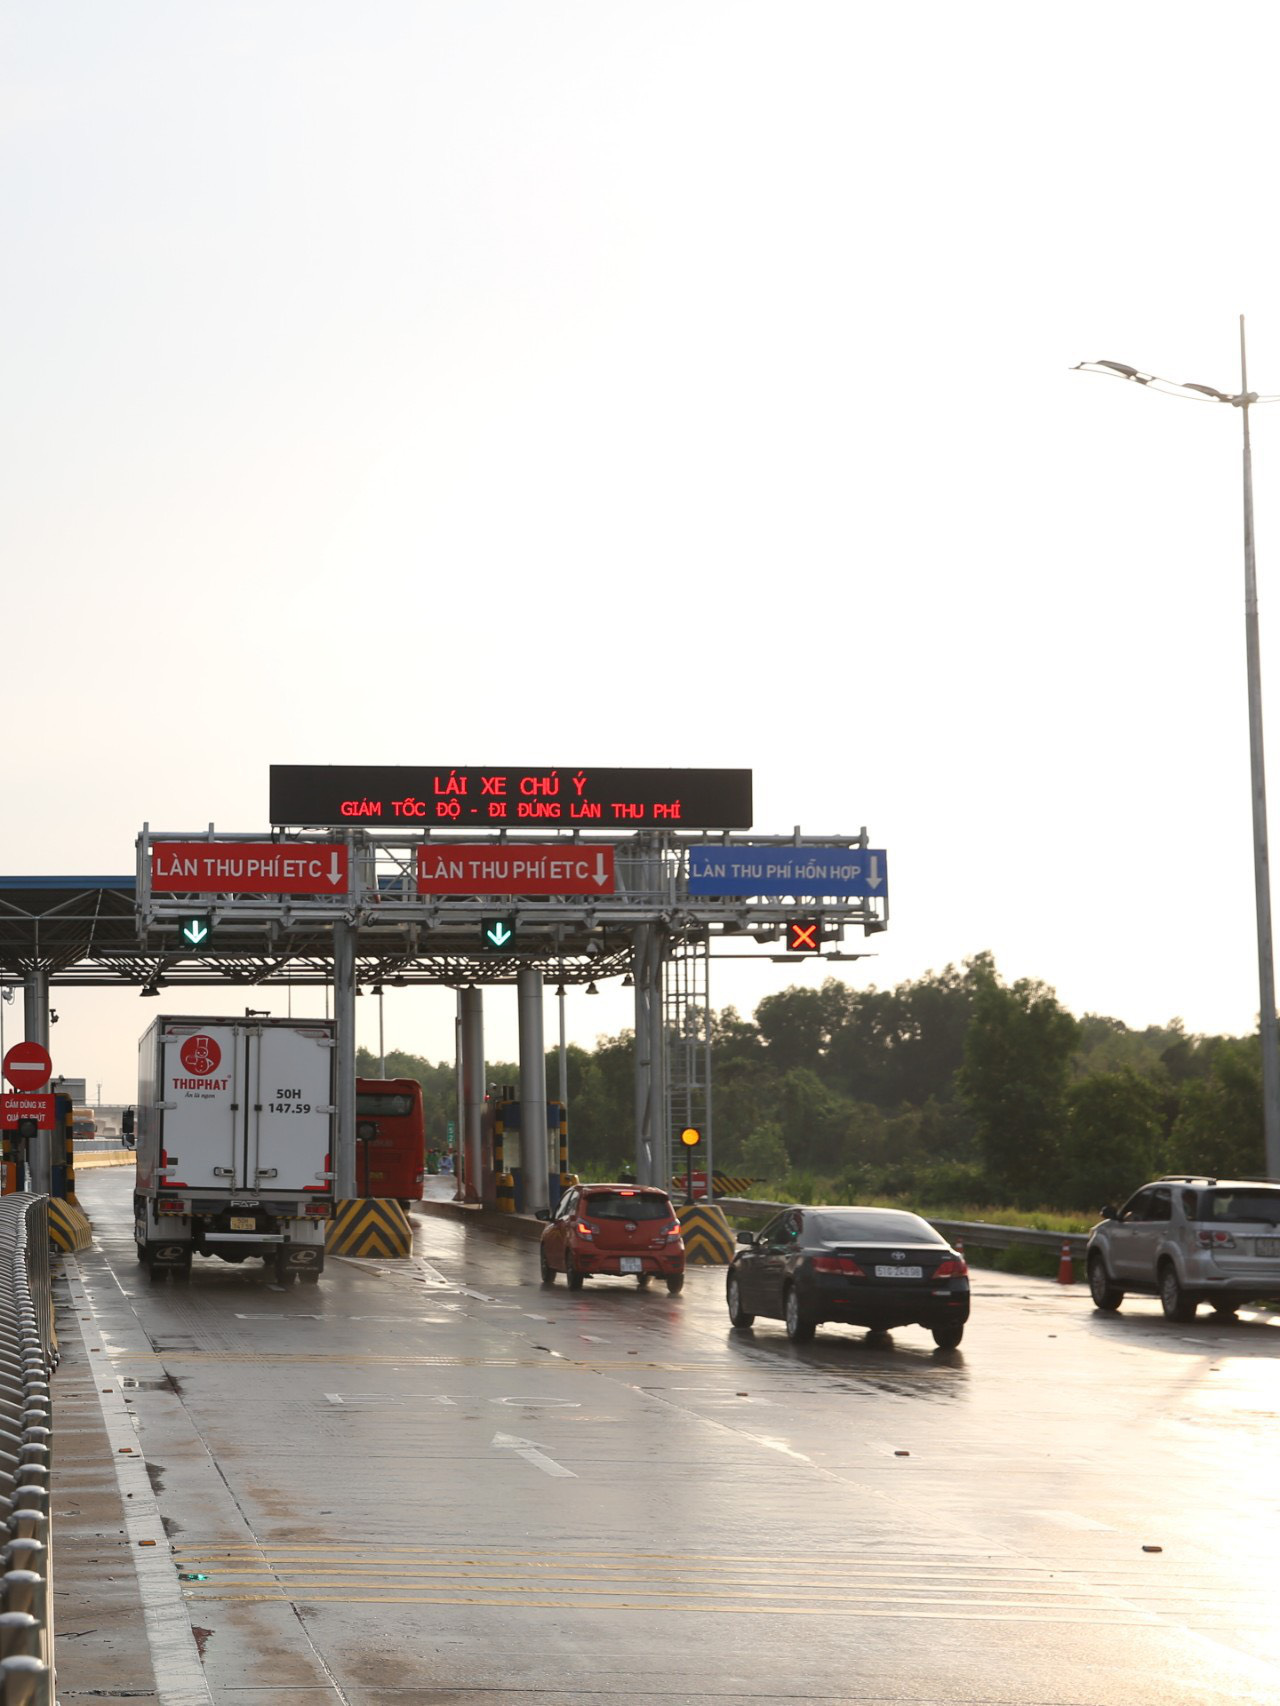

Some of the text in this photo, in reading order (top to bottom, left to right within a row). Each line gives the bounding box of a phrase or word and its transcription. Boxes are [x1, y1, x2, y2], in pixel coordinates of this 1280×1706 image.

[433, 770, 587, 796] LÁI XE CHÚ Ý
[435, 798, 461, 820] ĐỘ
[488, 802, 507, 818] ĐI
[517, 798, 561, 818] ĐÚNG
[570, 800, 602, 819] LÀN
[610, 803, 644, 819] THU
[652, 800, 681, 819] PHÍ
[156, 853, 322, 878] LÀN THU PHÍ ETC
[421, 856, 588, 880] LÀN THU PHÍ ETC
[693, 858, 861, 882] LÀN THU PHÍ HỖN HỢP
[172, 1078, 228, 1091] THOPHAT
[276, 1088, 302, 1100] 50H
[38, 1101, 47, 1109] XE
[268, 1103, 312, 1114] 147.59
